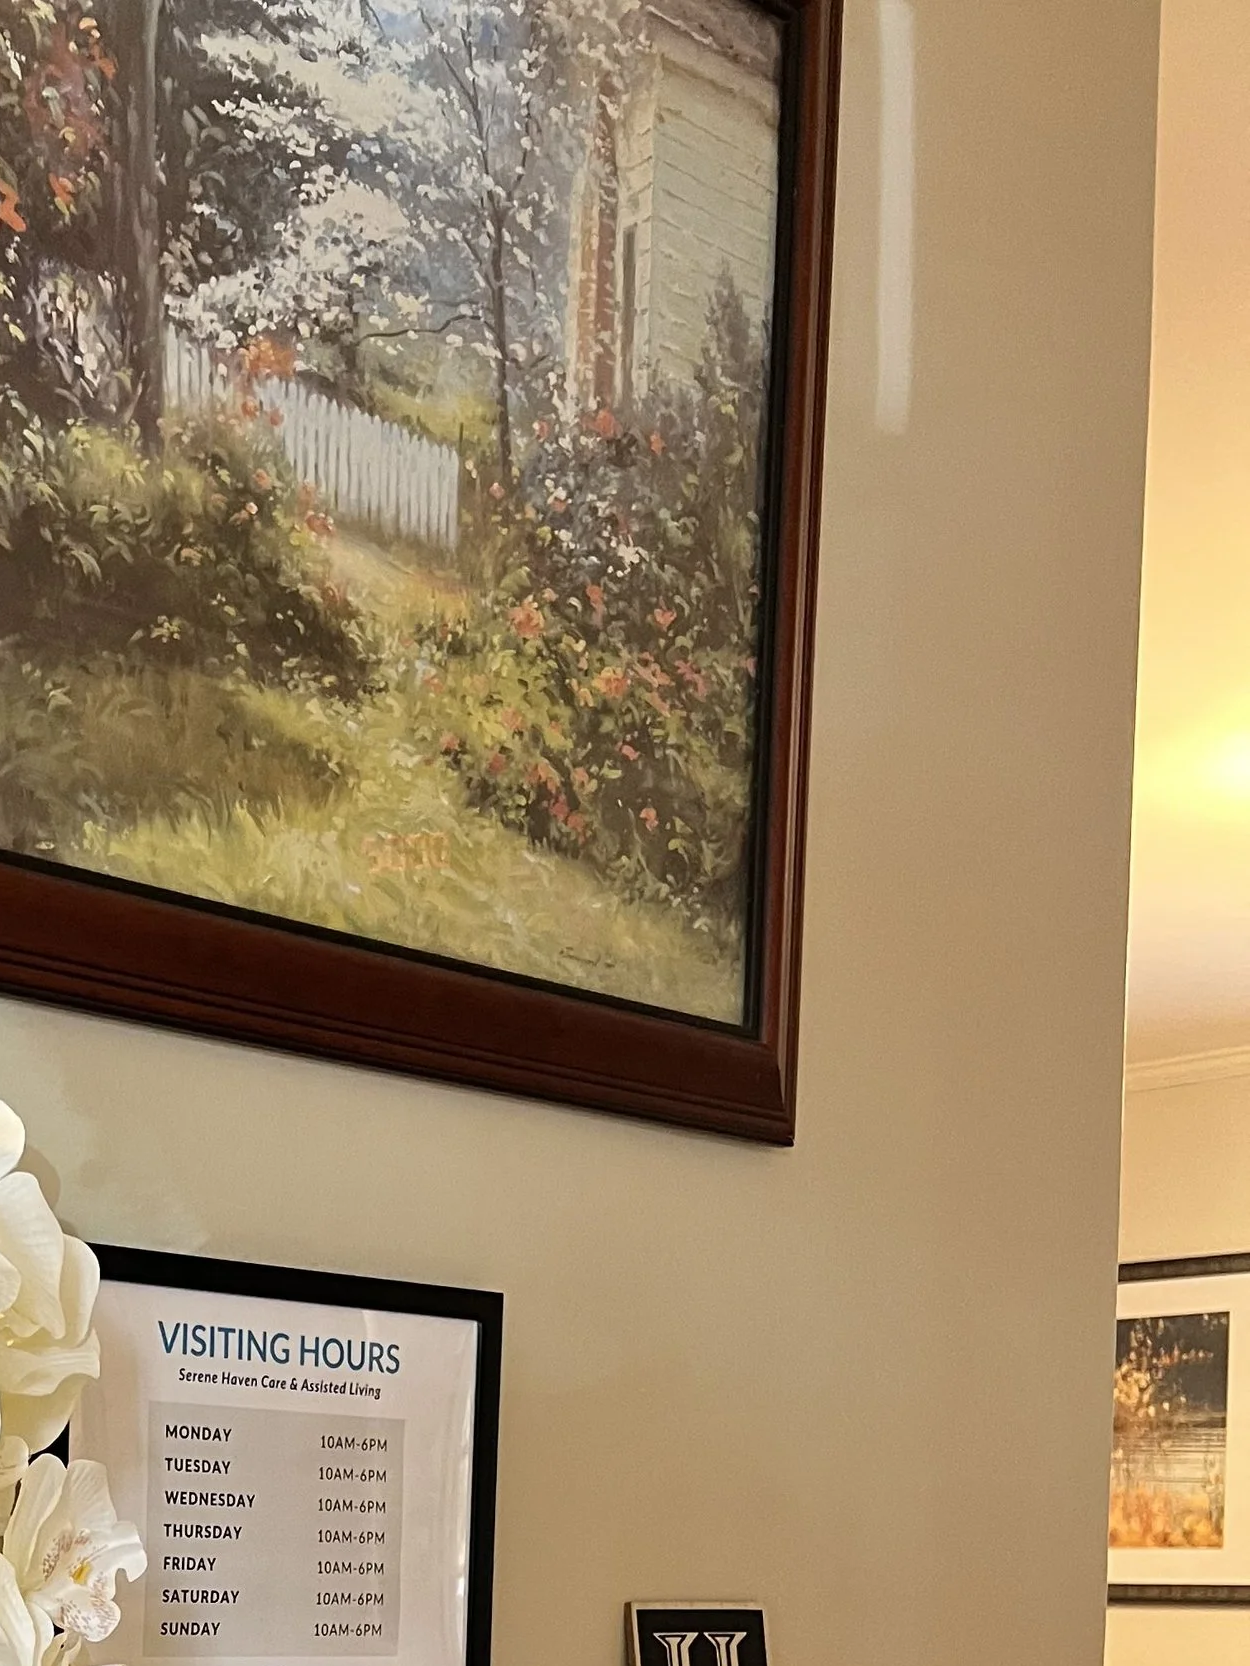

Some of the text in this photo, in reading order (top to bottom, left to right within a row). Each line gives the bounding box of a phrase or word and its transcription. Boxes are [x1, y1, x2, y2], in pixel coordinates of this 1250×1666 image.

[158, 1320, 400, 1374] VISITING HOURS
[179, 1368, 382, 1400] Serene Haven Care & Assisted Living
[165, 1424, 388, 1452] MONDAY 10AM-6PM
[165, 1457, 387, 1483] TUESDAY 10AM-6PM
[165, 1490, 387, 1514] WEDNESDAY 10AM-6PM
[163, 1523, 386, 1545] THURSDAY 10AM-6PM
[163, 1556, 385, 1576] FRIDAY 10AM-6PM
[162, 1589, 384, 1607] SATURDAY 10AM-6PM
[160, 1622, 383, 1638] SUNDAY 10AM-6PM
